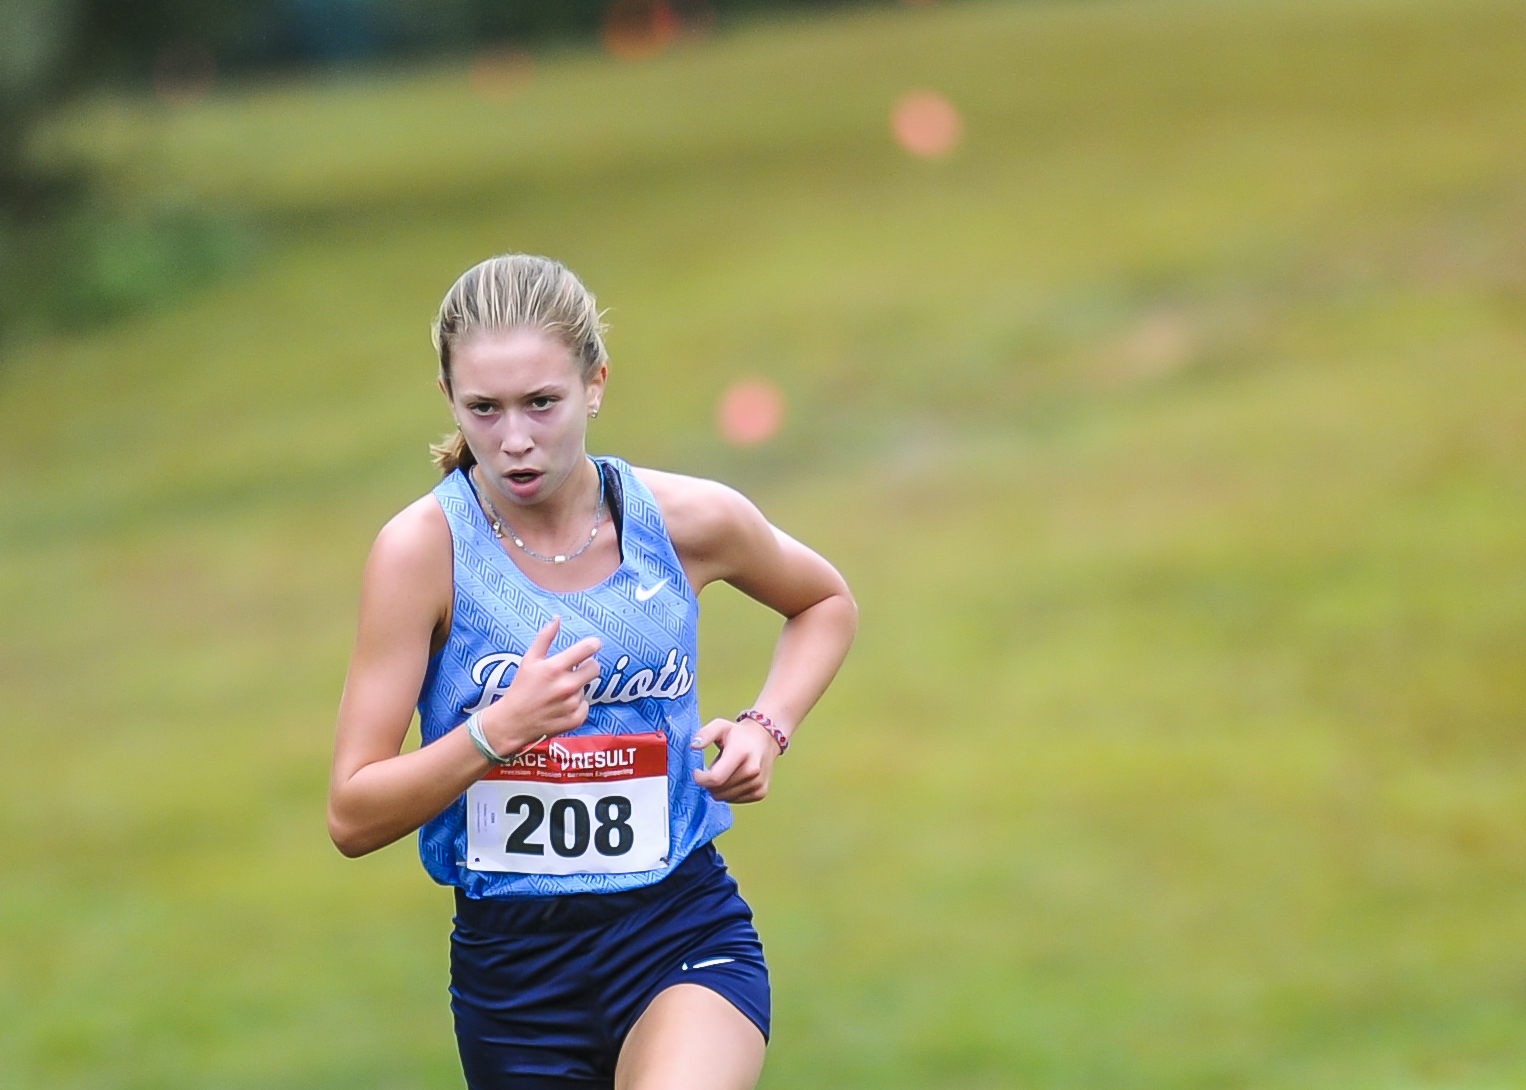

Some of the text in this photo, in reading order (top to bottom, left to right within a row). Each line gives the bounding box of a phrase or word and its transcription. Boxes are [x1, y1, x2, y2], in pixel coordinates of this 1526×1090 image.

[463, 647, 695, 714] Priots
[500, 747, 637, 769] ACE RESULT
[505, 794, 635, 858] 208
